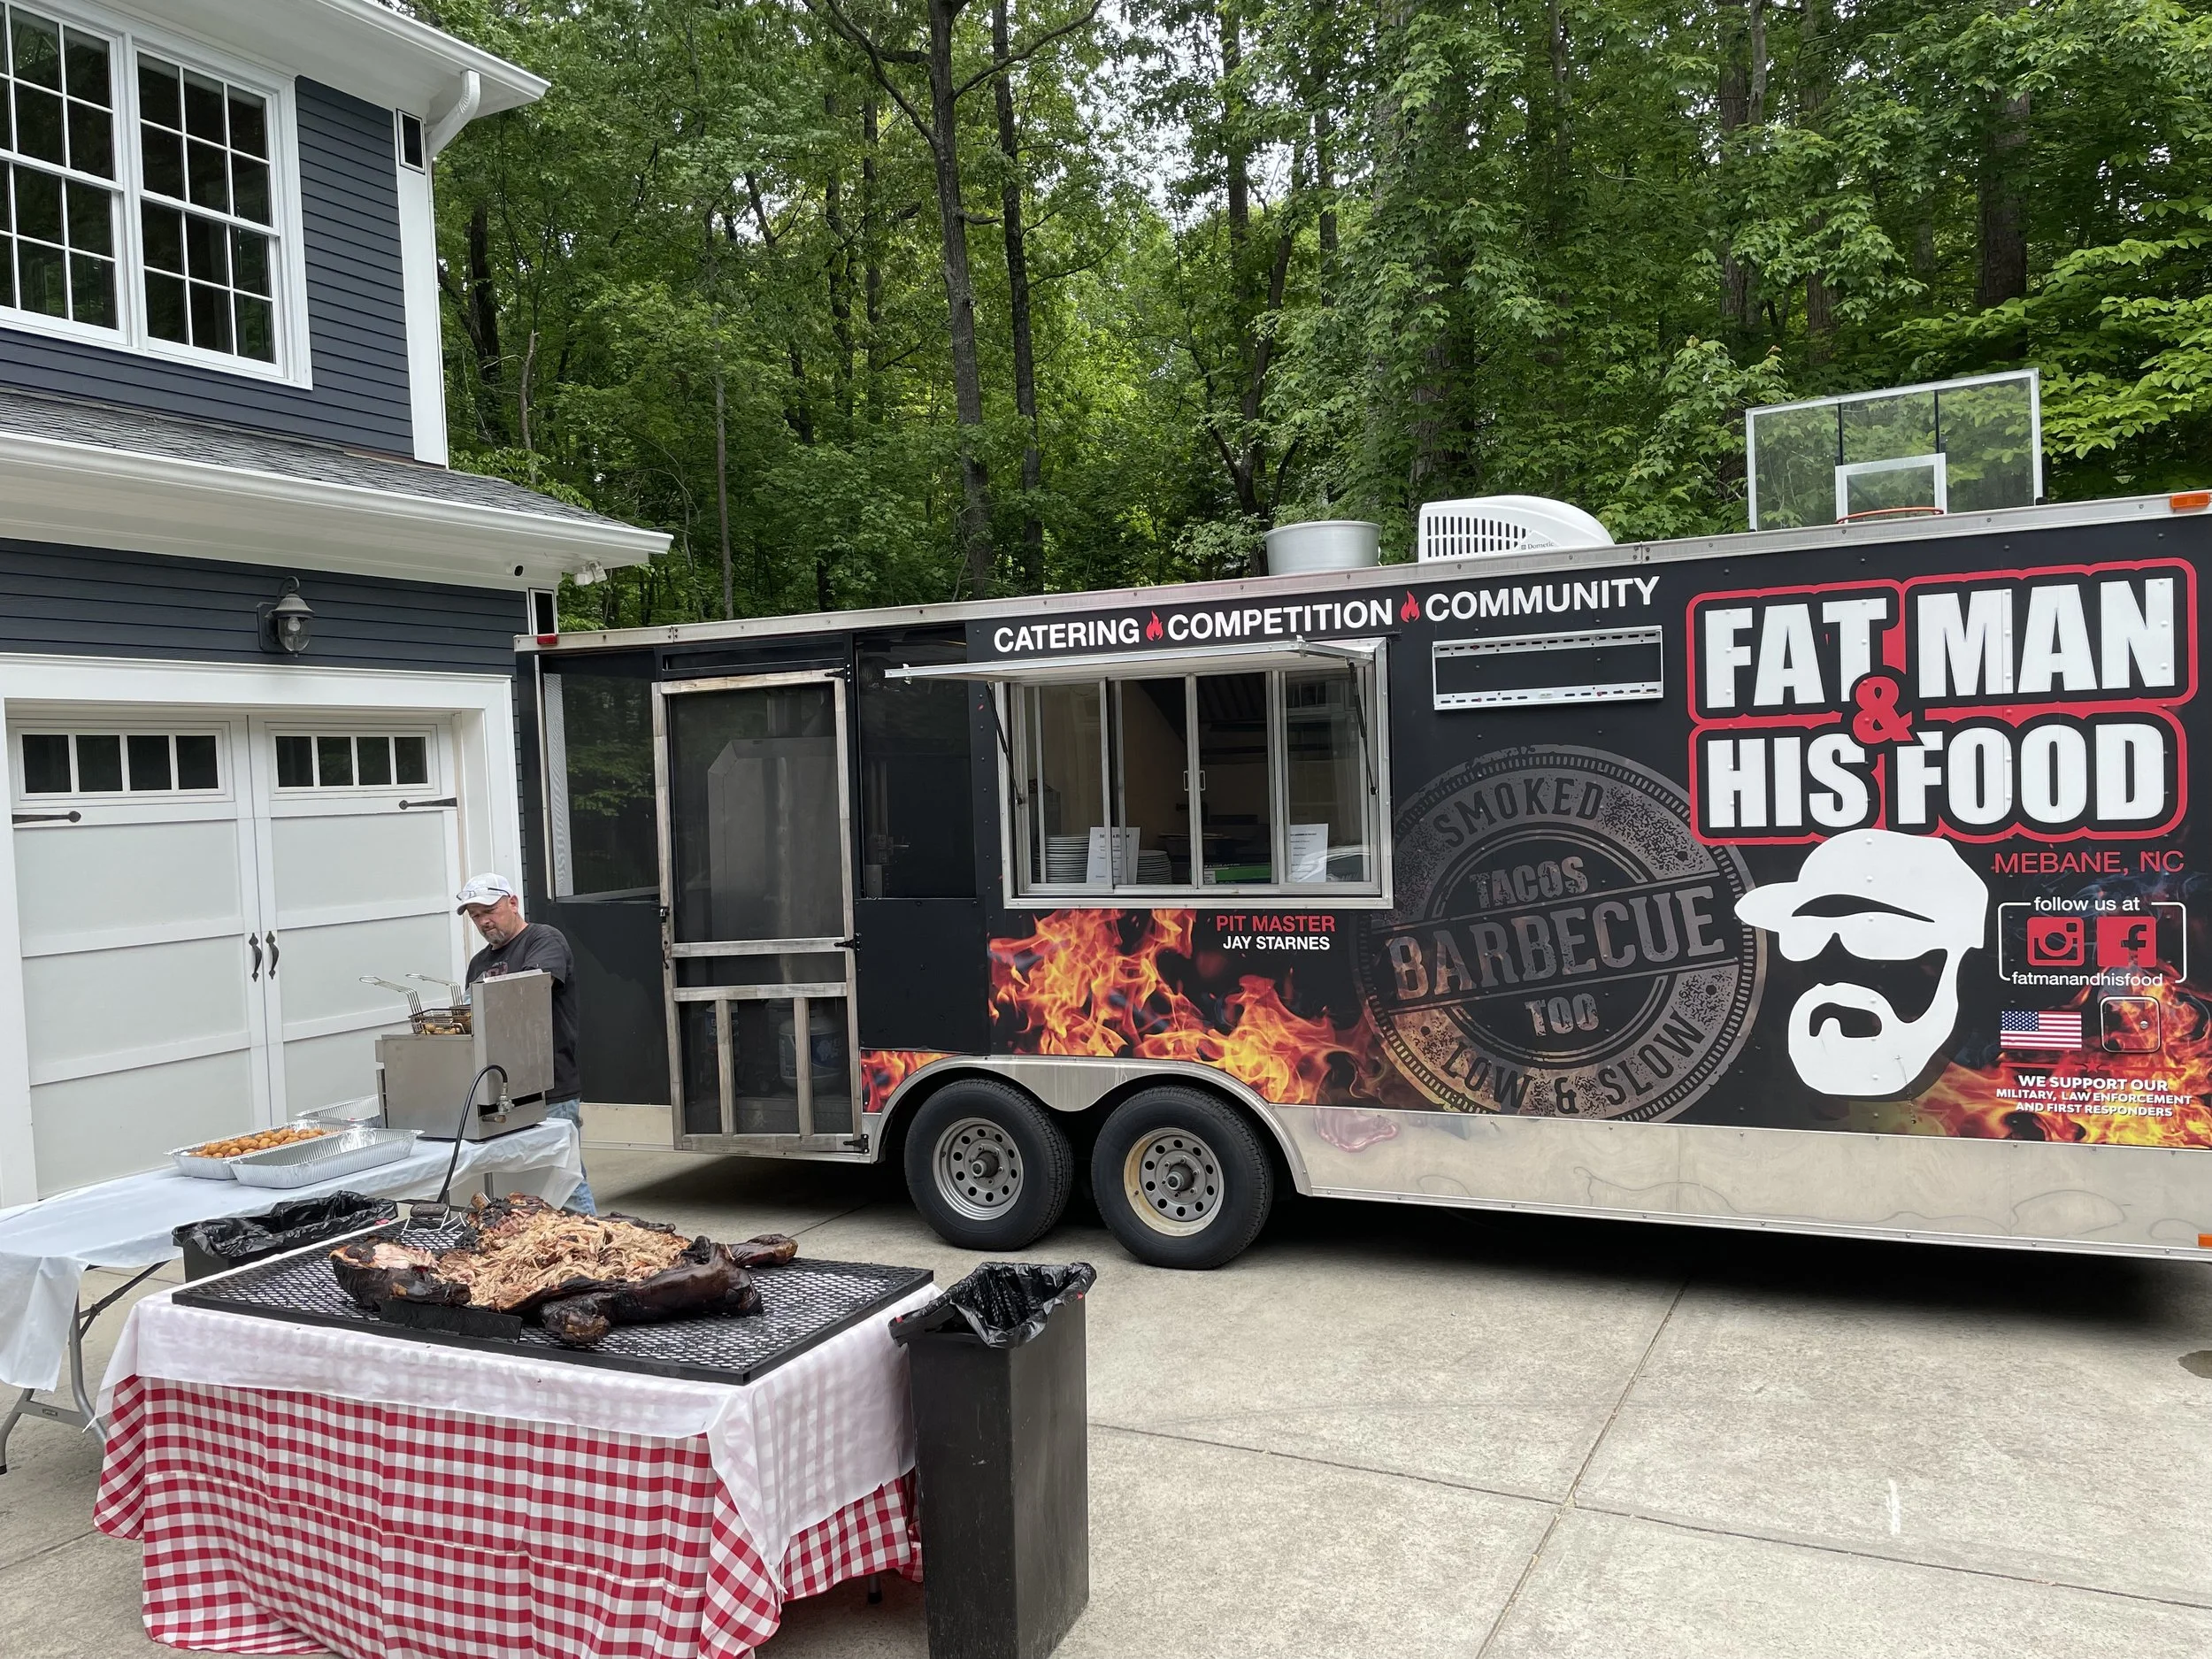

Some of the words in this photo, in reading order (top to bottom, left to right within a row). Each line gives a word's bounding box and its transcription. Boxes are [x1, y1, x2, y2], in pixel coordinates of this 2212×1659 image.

[994, 618, 1140, 653] CATERING
[1168, 598, 1393, 641] COMPETITION
[1425, 576, 1660, 621] COMMUNITY
[1705, 597, 1887, 708] FAT
[1917, 578, 2176, 699] MAN
[1852, 675, 1914, 744] &
[1707, 733, 1868, 828] HIS
[1897, 723, 2165, 825] FOOD
[1432, 777, 1604, 848] SMOKED
[1468, 855, 1589, 910] TACOS
[1994, 851, 2129, 876] MEBANE,
[2139, 850, 2185, 873] NC
[1216, 915, 1247, 932] PIT
[1252, 915, 1336, 933] MASTER
[2033, 896, 2088, 911] follow
[2094, 900, 2116, 911] us
[2122, 897, 2140, 911] at
[1223, 935, 1252, 949] JAY
[1256, 936, 1331, 950] STARNES
[1386, 886, 1725, 1002] BARBECUE
[2011, 972, 2163, 987] fatmanandhisfood
[1525, 992, 1600, 1037] TOO
[1440, 1040, 1535, 1109] LOW
[1554, 1076, 1579, 1114] &
[1597, 1006, 1706, 1106] SLOW
[1996, 1089, 2056, 1102] MILITARY,
[2061, 1091, 2092, 1102] LAW
[2093, 1092, 2192, 1105] ENFORCEMENT
[2018, 1075, 2046, 1088] WE
[2049, 1077, 2127, 1090] SUPPORT
[2131, 1079, 2168, 1092] OUR
[2016, 1102, 2044, 1113] AND
[2047, 1104, 2082, 1114] FIRST
[2085, 1105, 2173, 1118] RESPONDERS
